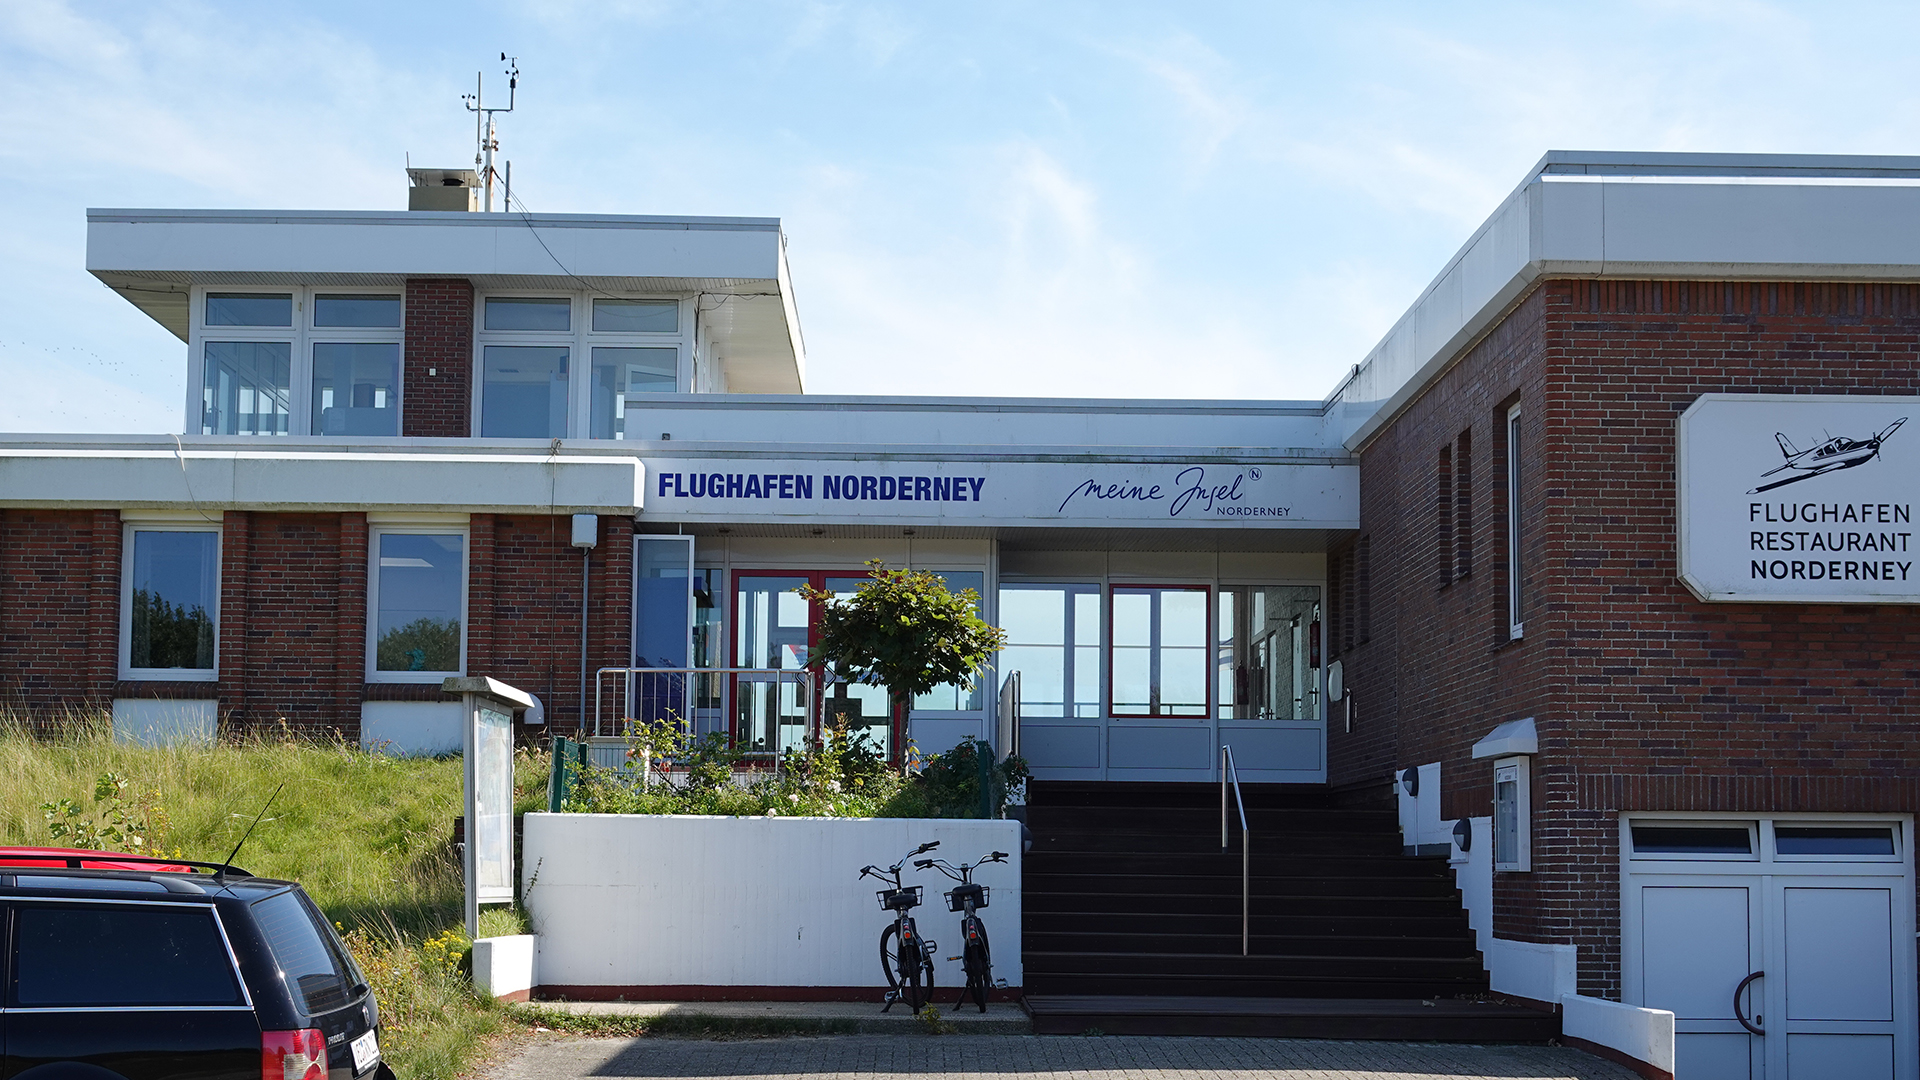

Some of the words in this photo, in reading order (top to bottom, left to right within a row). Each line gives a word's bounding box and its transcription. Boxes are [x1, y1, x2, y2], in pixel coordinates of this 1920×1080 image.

[658, 472, 813, 500] FLUGHAFEN
[822, 475, 986, 502] NORDERNEY
[1058, 478, 1165, 513] meine
[1216, 506, 1291, 517] NORDERNEY
[1750, 502, 1910, 524] FLUGHAFEN
[1750, 531, 1912, 552] RESTAURANT
[1751, 559, 1913, 581] NORDERNEY
